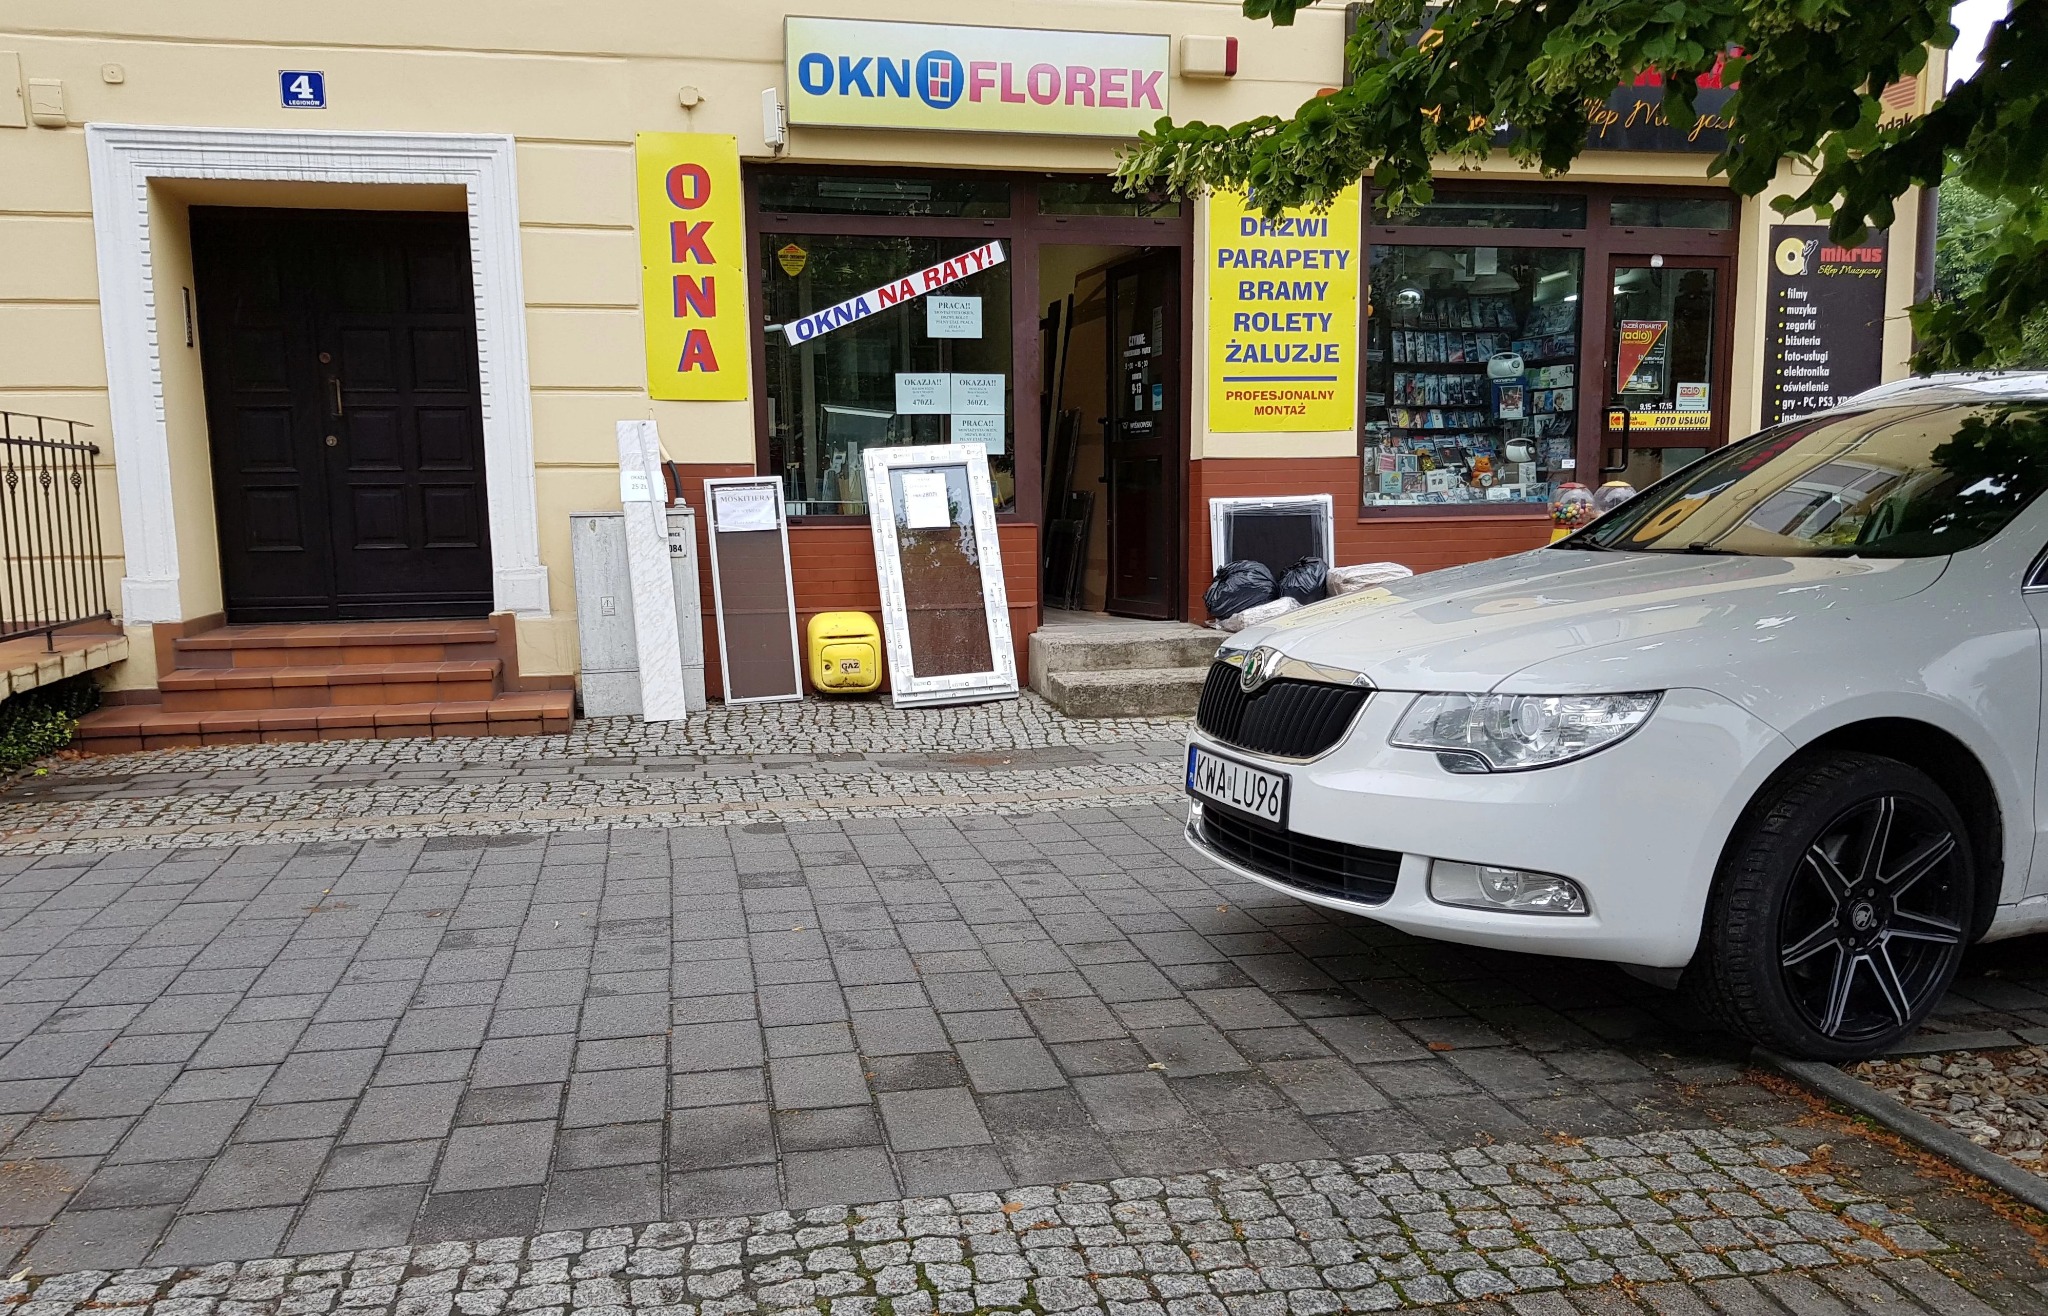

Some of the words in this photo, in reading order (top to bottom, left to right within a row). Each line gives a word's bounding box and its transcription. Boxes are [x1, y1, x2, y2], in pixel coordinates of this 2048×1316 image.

[290, 75, 314, 99] 4
[968, 61, 1165, 110] FLOREK
[1240, 216, 1328, 238] DRZWI
[1217, 248, 1350, 270] PARAPETY
[1820, 246, 1883, 263] mikrus
[665, 163, 720, 373] OKNA
[1817, 264, 1838, 278] Sklep
[1839, 264, 1883, 279] Muzyczny
[795, 296, 872, 341] OKNA
[877, 278, 916, 309] NA
[922, 243, 994, 291] RATY!
[1238, 280, 1329, 301] BRAMY
[1787, 288, 1808, 302] filmy
[1786, 304, 1817, 317] muzyka
[1233, 312, 1333, 333] ROLETY
[1785, 319, 1816, 333] zegarki
[1621, 330, 1649, 340] radio
[1785, 335, 1821, 346] biżuteria
[1225, 338, 1340, 364] ŻALUZJE
[1784, 350, 1829, 364] foto-usługi
[1783, 365, 1830, 377] elektronika
[959, 379, 997, 387] OKAZJA!!
[1782, 381, 1829, 393] oświetlenie
[1225, 389, 1335, 401] PROFESJONALNY
[1253, 402, 1306, 416] MONTAŻ
[1782, 399, 1796, 410] gry
[1803, 396, 1817, 408] PC,
[1818, 396, 1836, 408] PS3,
[962, 419, 994, 427] PRACA!!
[1655, 416, 1677, 425] FOTO
[1678, 416, 1709, 425] USŁUGI
[719, 494, 771, 503] MOSKITIERA
[668, 544, 683, 553] 084
[841, 662, 860, 672] GAZ
